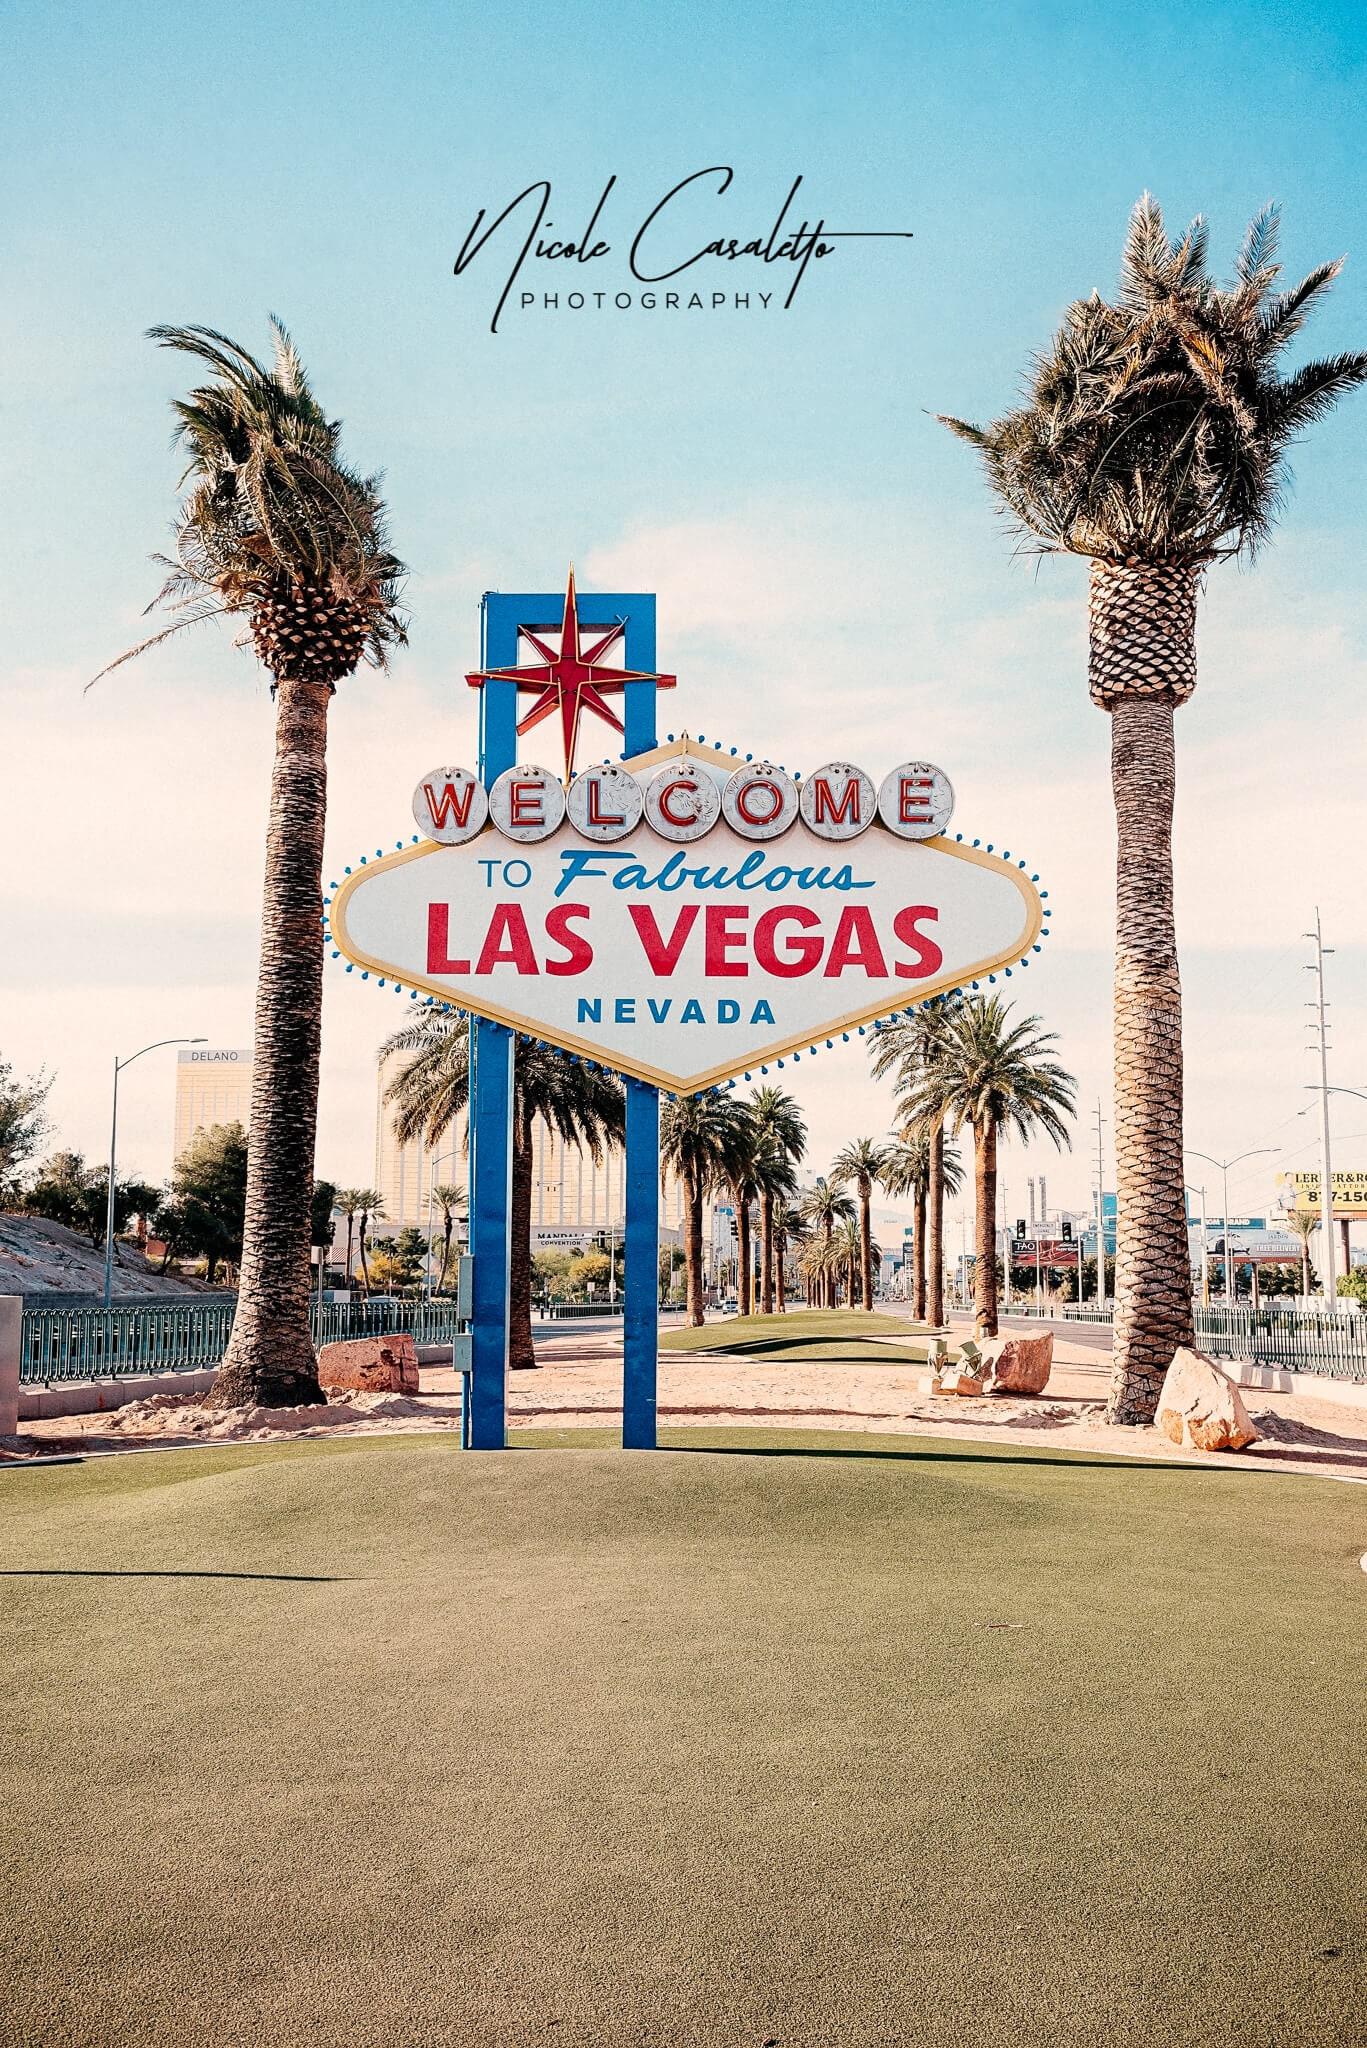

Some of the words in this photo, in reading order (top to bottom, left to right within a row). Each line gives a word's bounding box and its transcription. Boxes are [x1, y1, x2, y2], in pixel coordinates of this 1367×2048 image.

[423, 778, 934, 829] WELCOME
[478, 859, 532, 888] TO
[554, 850, 875, 898] Fabulous
[426, 903, 593, 976] LAS
[627, 904, 943, 978] VEGAS
[577, 998, 775, 1025] NEVADA
[191, 1052, 238, 1061] DELANO
[1295, 1173, 1367, 1183] LERER&R
[1308, 1191, 1367, 1202] 87-15
[1014, 1242, 1035, 1251] TAO
